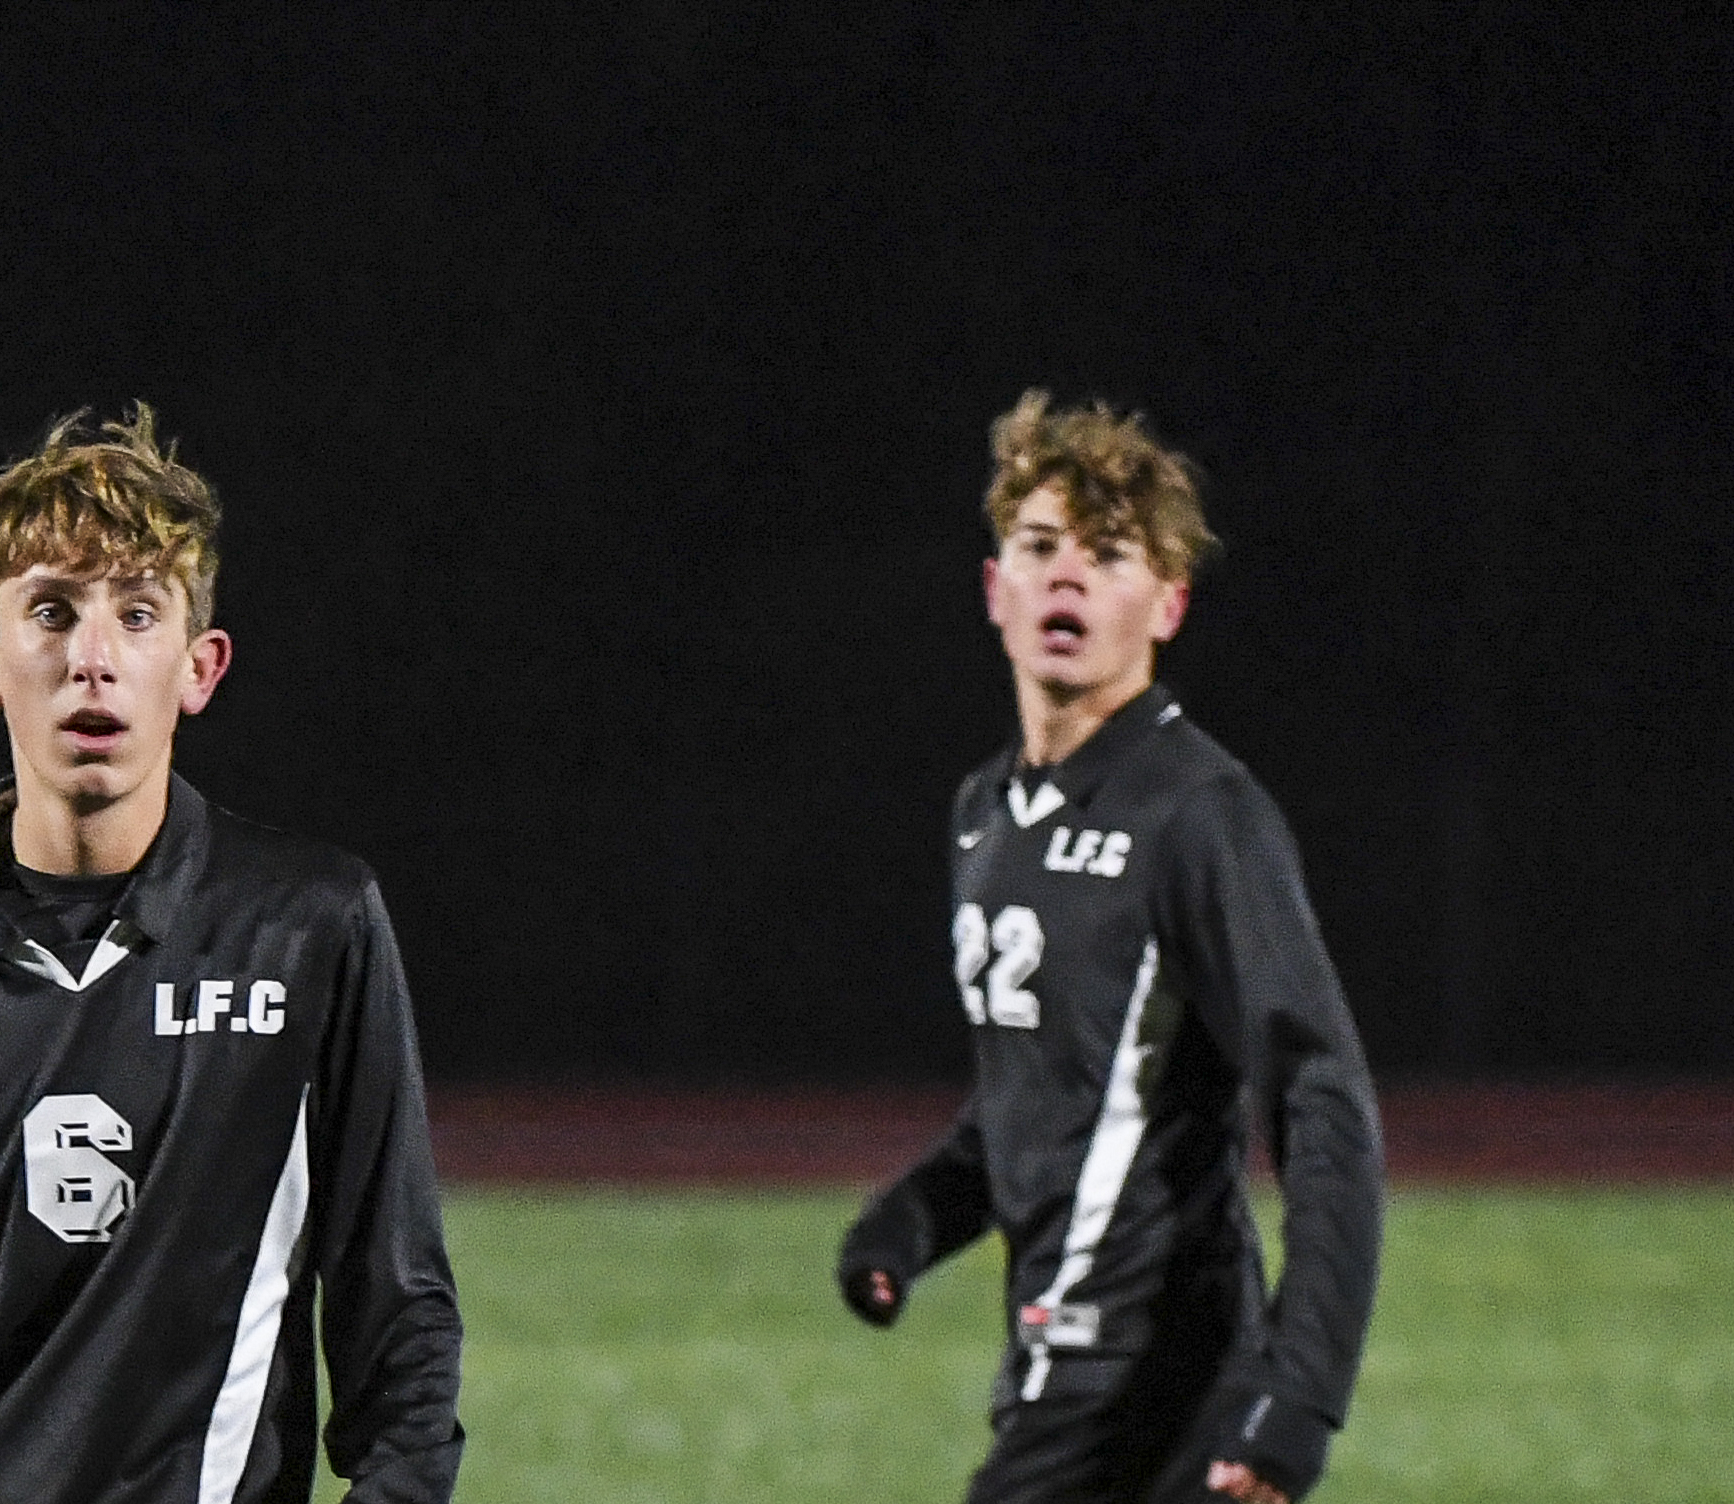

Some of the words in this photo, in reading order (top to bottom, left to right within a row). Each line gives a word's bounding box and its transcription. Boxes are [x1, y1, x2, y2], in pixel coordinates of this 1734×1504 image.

[154, 979, 286, 1036] L.F.C
[953, 902, 1045, 1029] 22
[22, 1093, 136, 1243] 6
